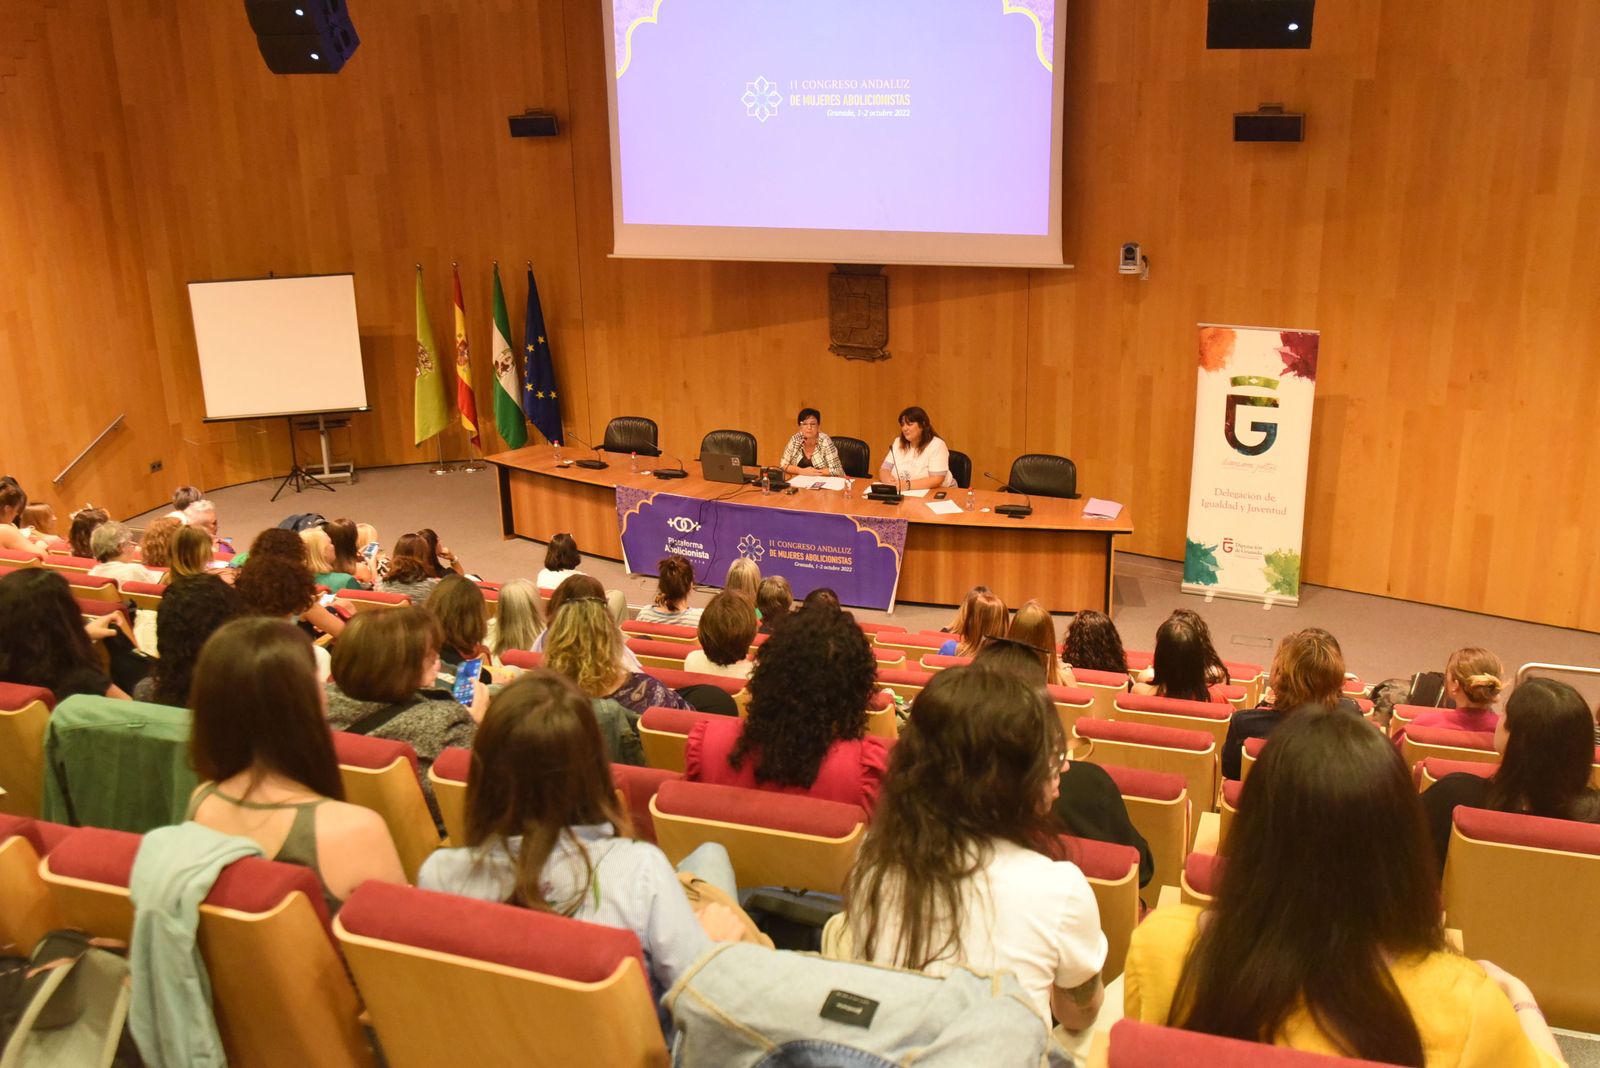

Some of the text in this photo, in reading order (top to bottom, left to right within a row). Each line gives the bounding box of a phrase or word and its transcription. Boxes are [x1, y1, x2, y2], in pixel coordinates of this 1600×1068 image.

[802, 79, 858, 90] CONGRESO
[860, 79, 911, 90] ANDALUZ
[790, 94, 911, 106] DE MUJERES ABOLICIONISTAS
[1264, 492, 1276, 502] de
[1201, 498, 1238, 510] Igualdad
[1247, 504, 1287, 515] Juventud
[664, 543, 710, 560] Aolicionista
[777, 540, 816, 551] CONGRESO
[817, 545, 852, 555] ANDALUZ
[769, 549, 853, 566] DE MUJERES ABOLICIONISTAS
